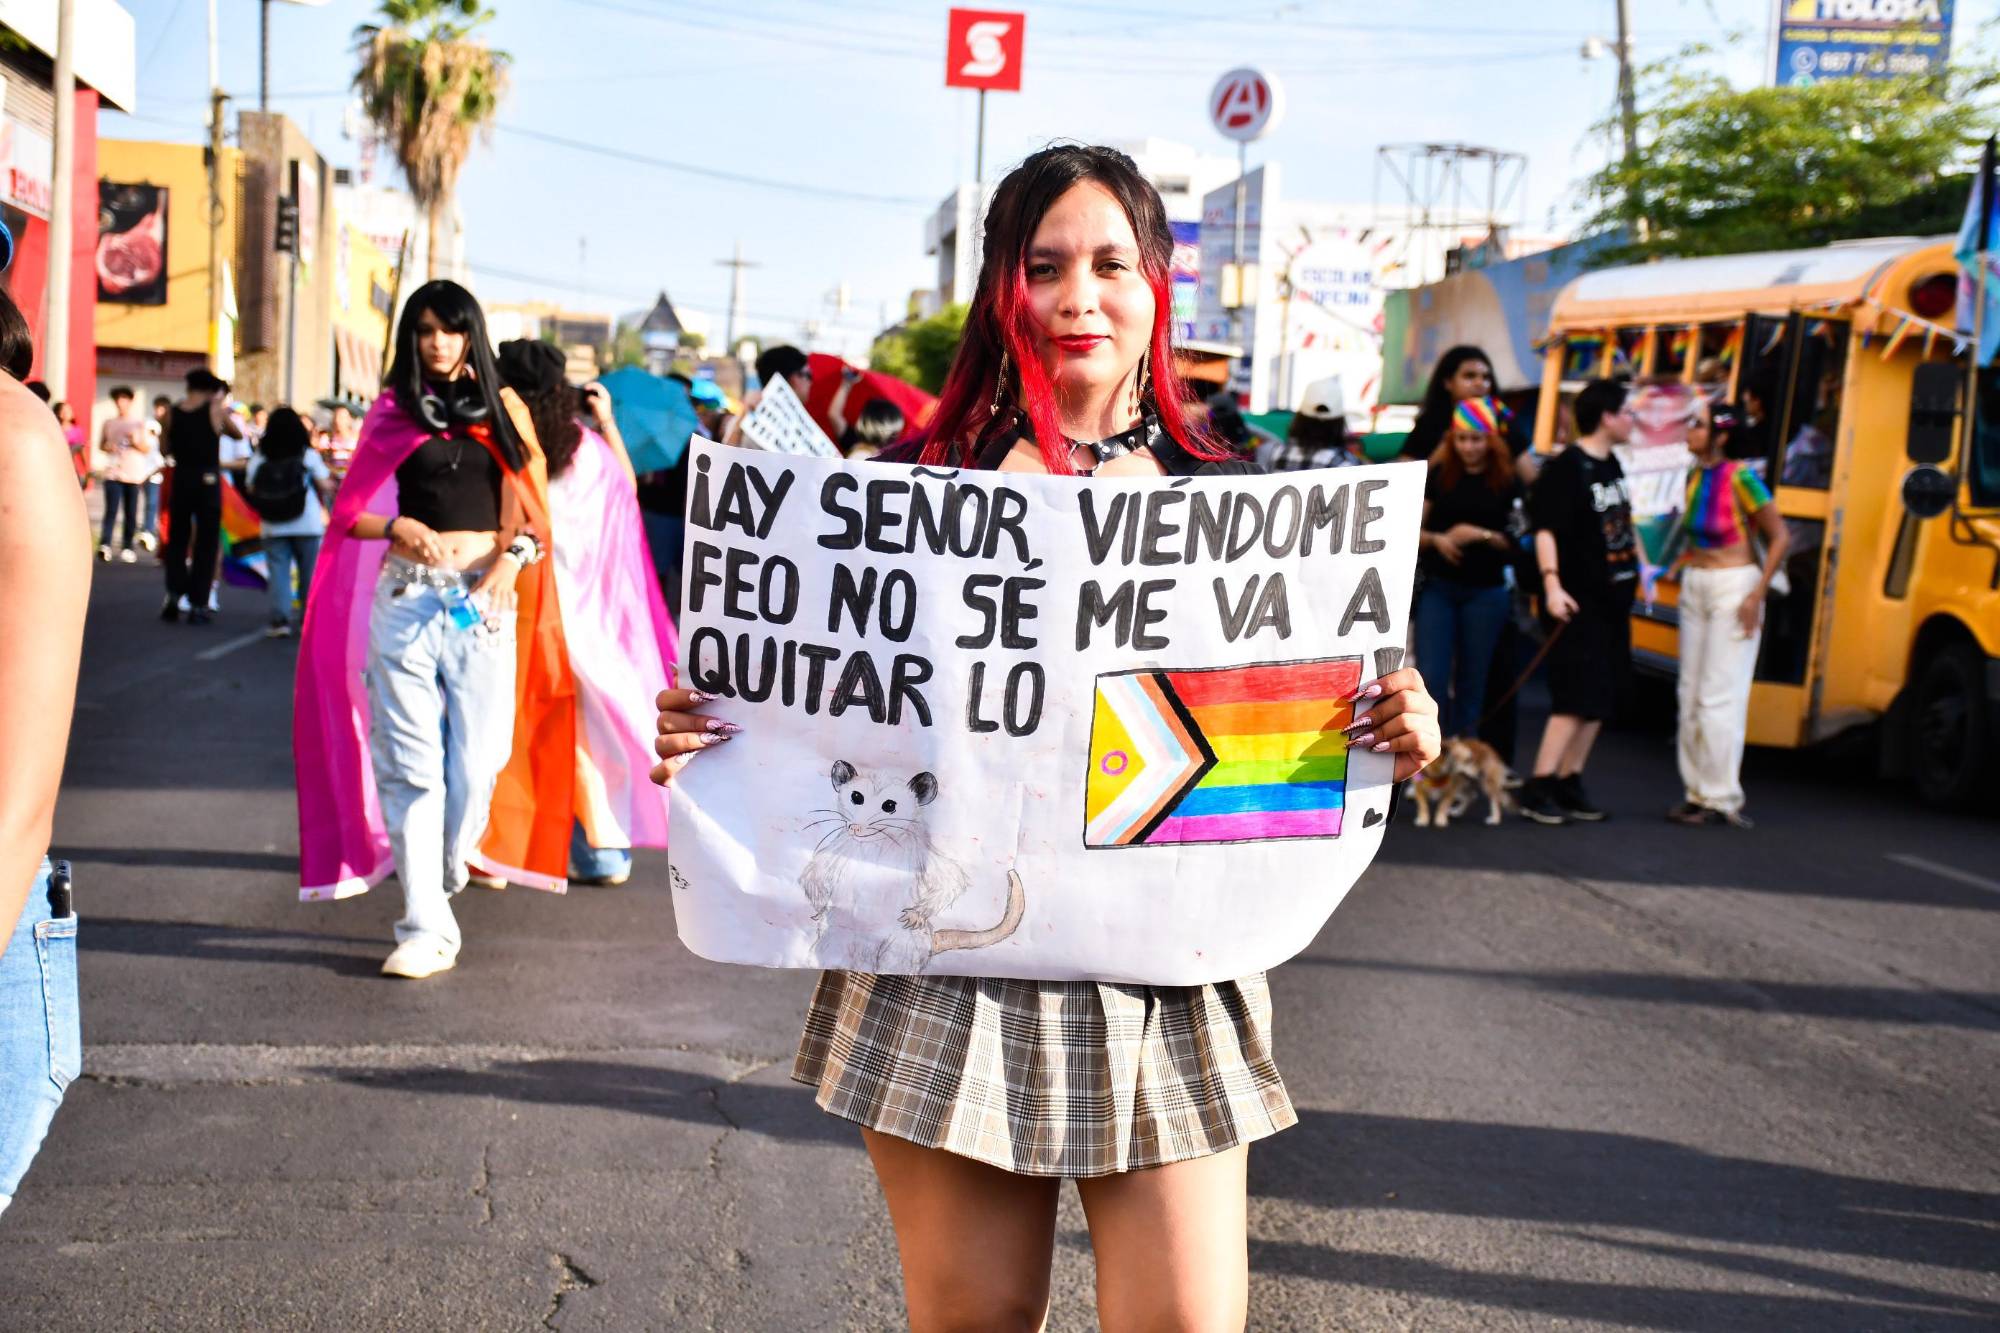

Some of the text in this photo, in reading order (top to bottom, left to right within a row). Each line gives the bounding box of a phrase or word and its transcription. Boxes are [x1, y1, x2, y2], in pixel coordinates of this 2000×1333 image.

[1077, 477, 1389, 566] VIÉNDOME
[689, 541, 799, 625] FEO
[828, 563, 917, 642] NO
[1076, 579, 1176, 651] ME
[1213, 572, 1291, 643] VA
[1337, 567, 1390, 637] A
[689, 627, 1045, 737] QUITAR LO
